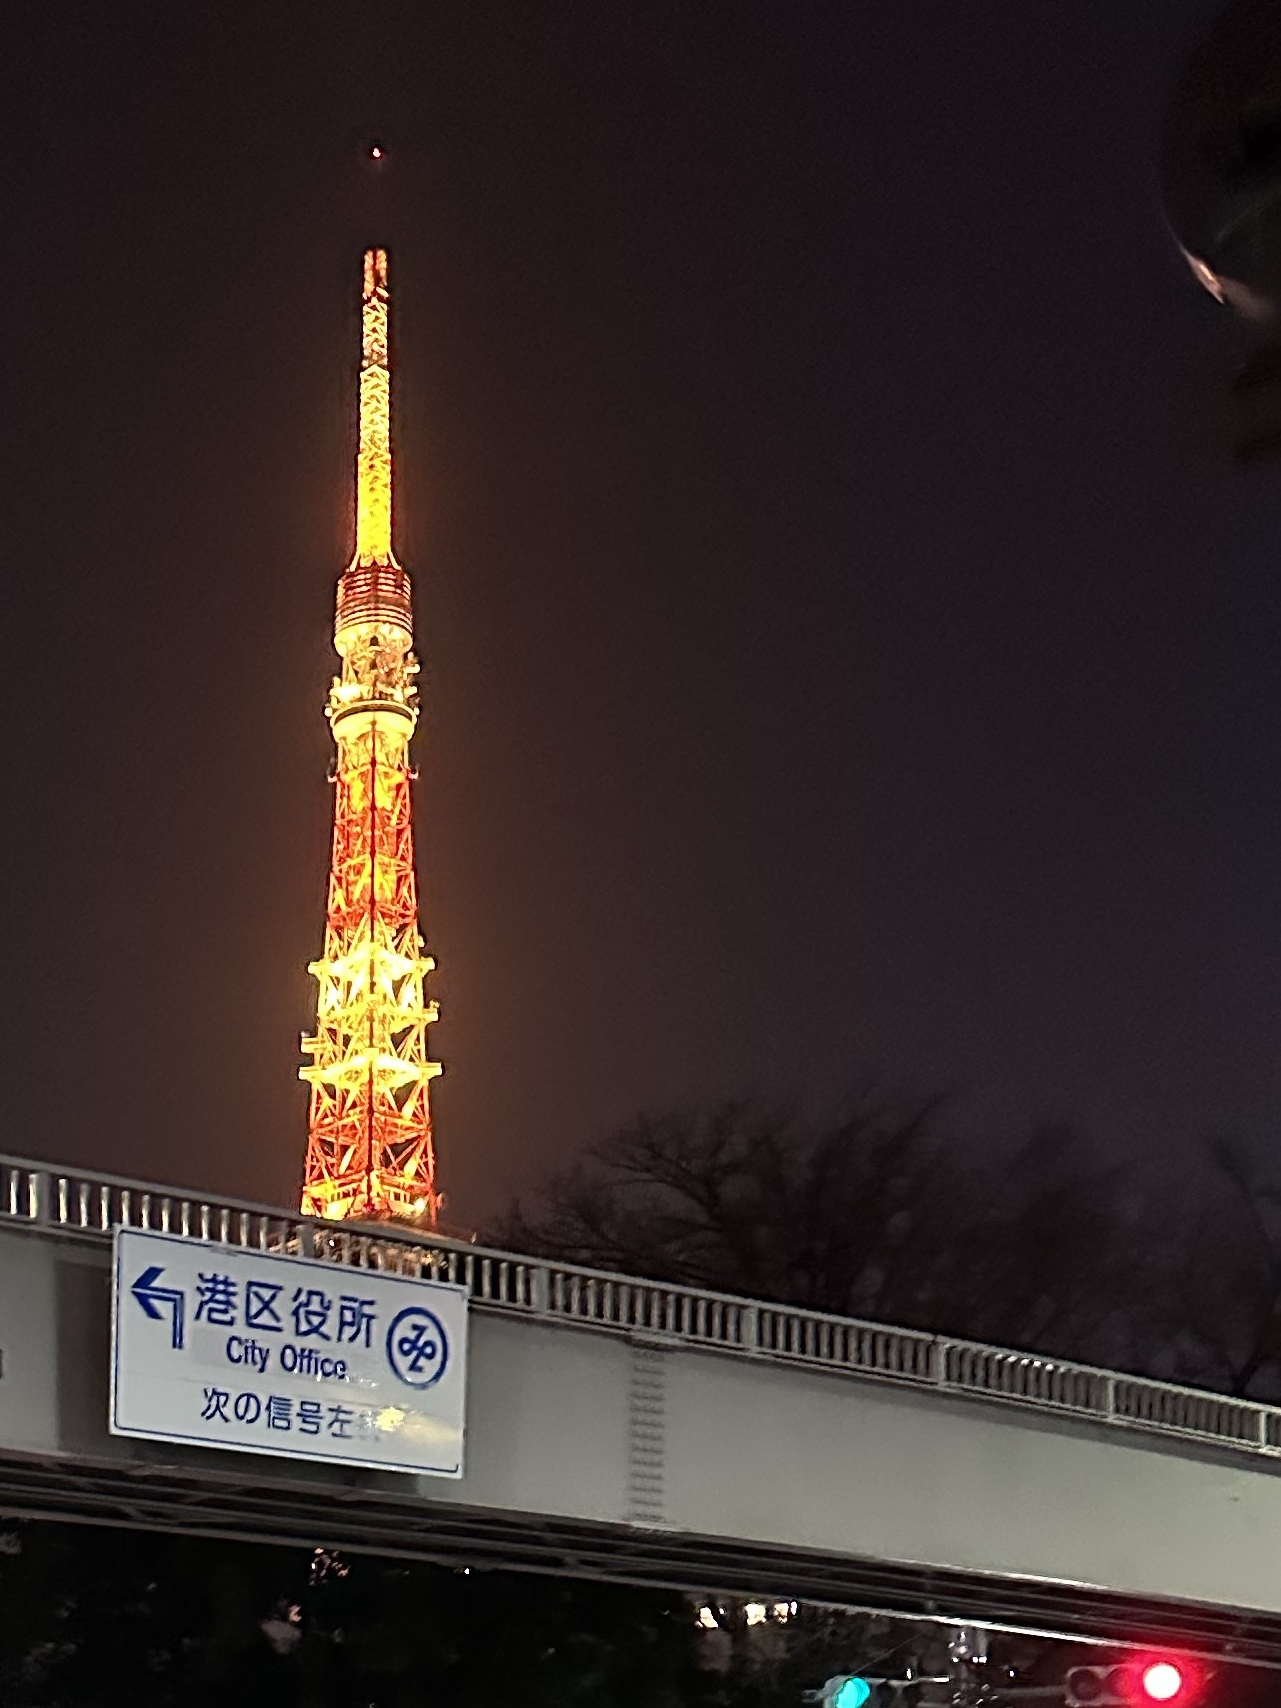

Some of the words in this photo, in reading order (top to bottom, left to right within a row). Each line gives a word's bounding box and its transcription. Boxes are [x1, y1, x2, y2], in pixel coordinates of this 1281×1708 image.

[195, 1272, 377, 1348] 港区役所
[225, 1335, 271, 1374] City
[280, 1343, 349, 1381] Office
[201, 1388, 382, 1441] 次の信号左
